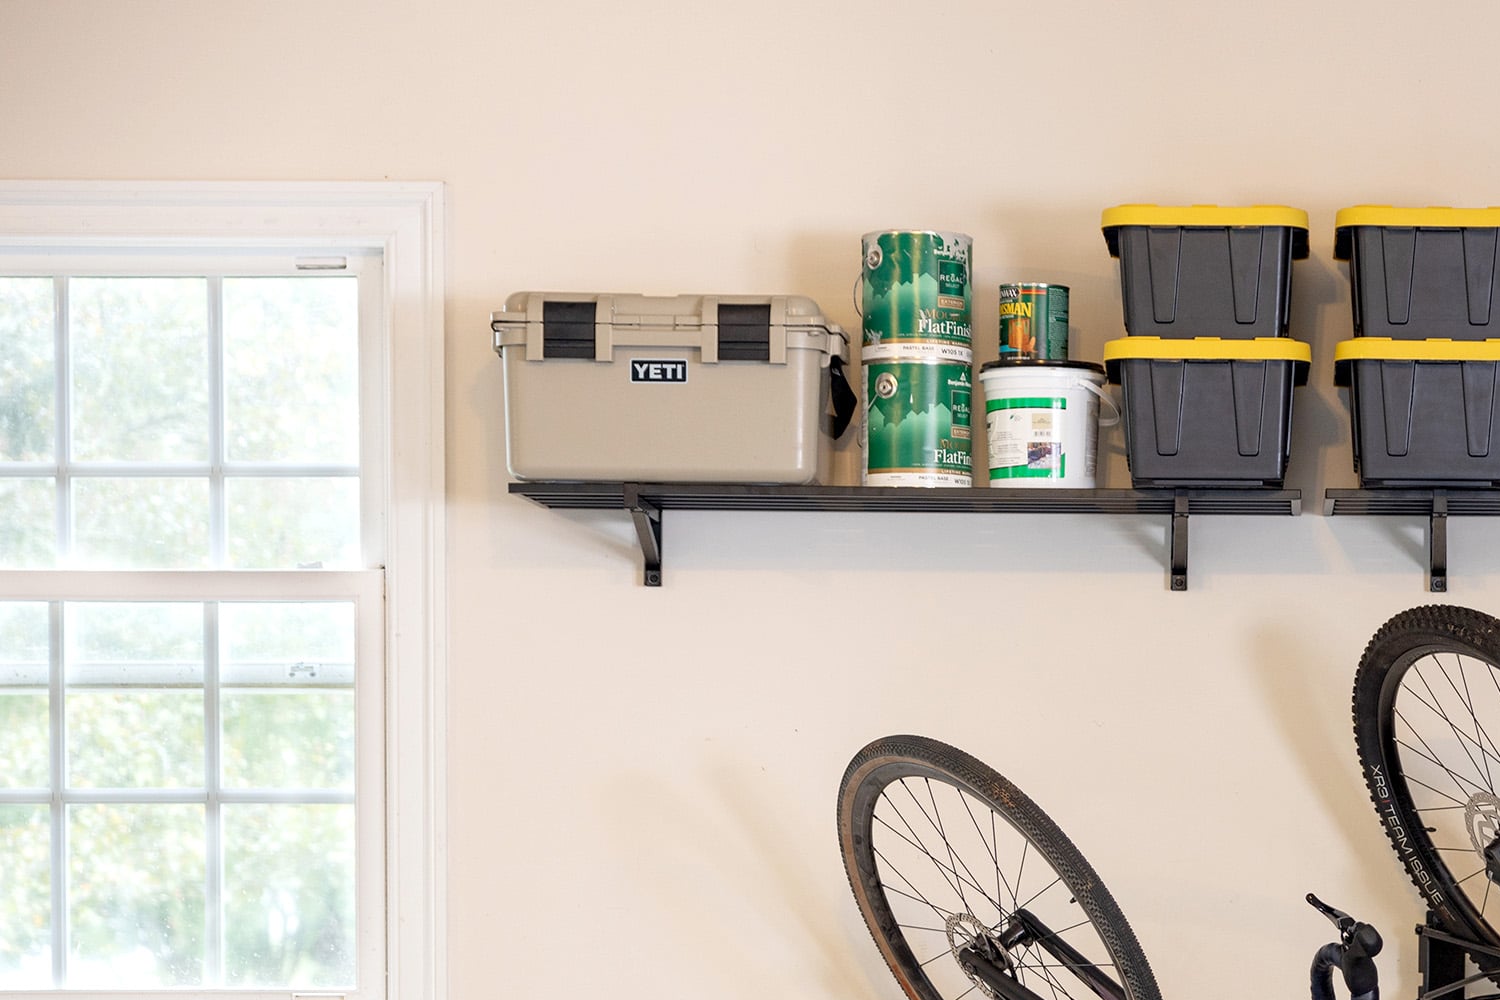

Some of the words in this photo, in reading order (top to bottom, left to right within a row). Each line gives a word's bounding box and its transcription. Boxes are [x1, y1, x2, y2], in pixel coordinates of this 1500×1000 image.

[634, 363, 682, 379] YETI
[1370, 764, 1389, 799] XR3
[1385, 804, 1414, 854] TEAM
[1408, 855, 1444, 905] ISSUE
